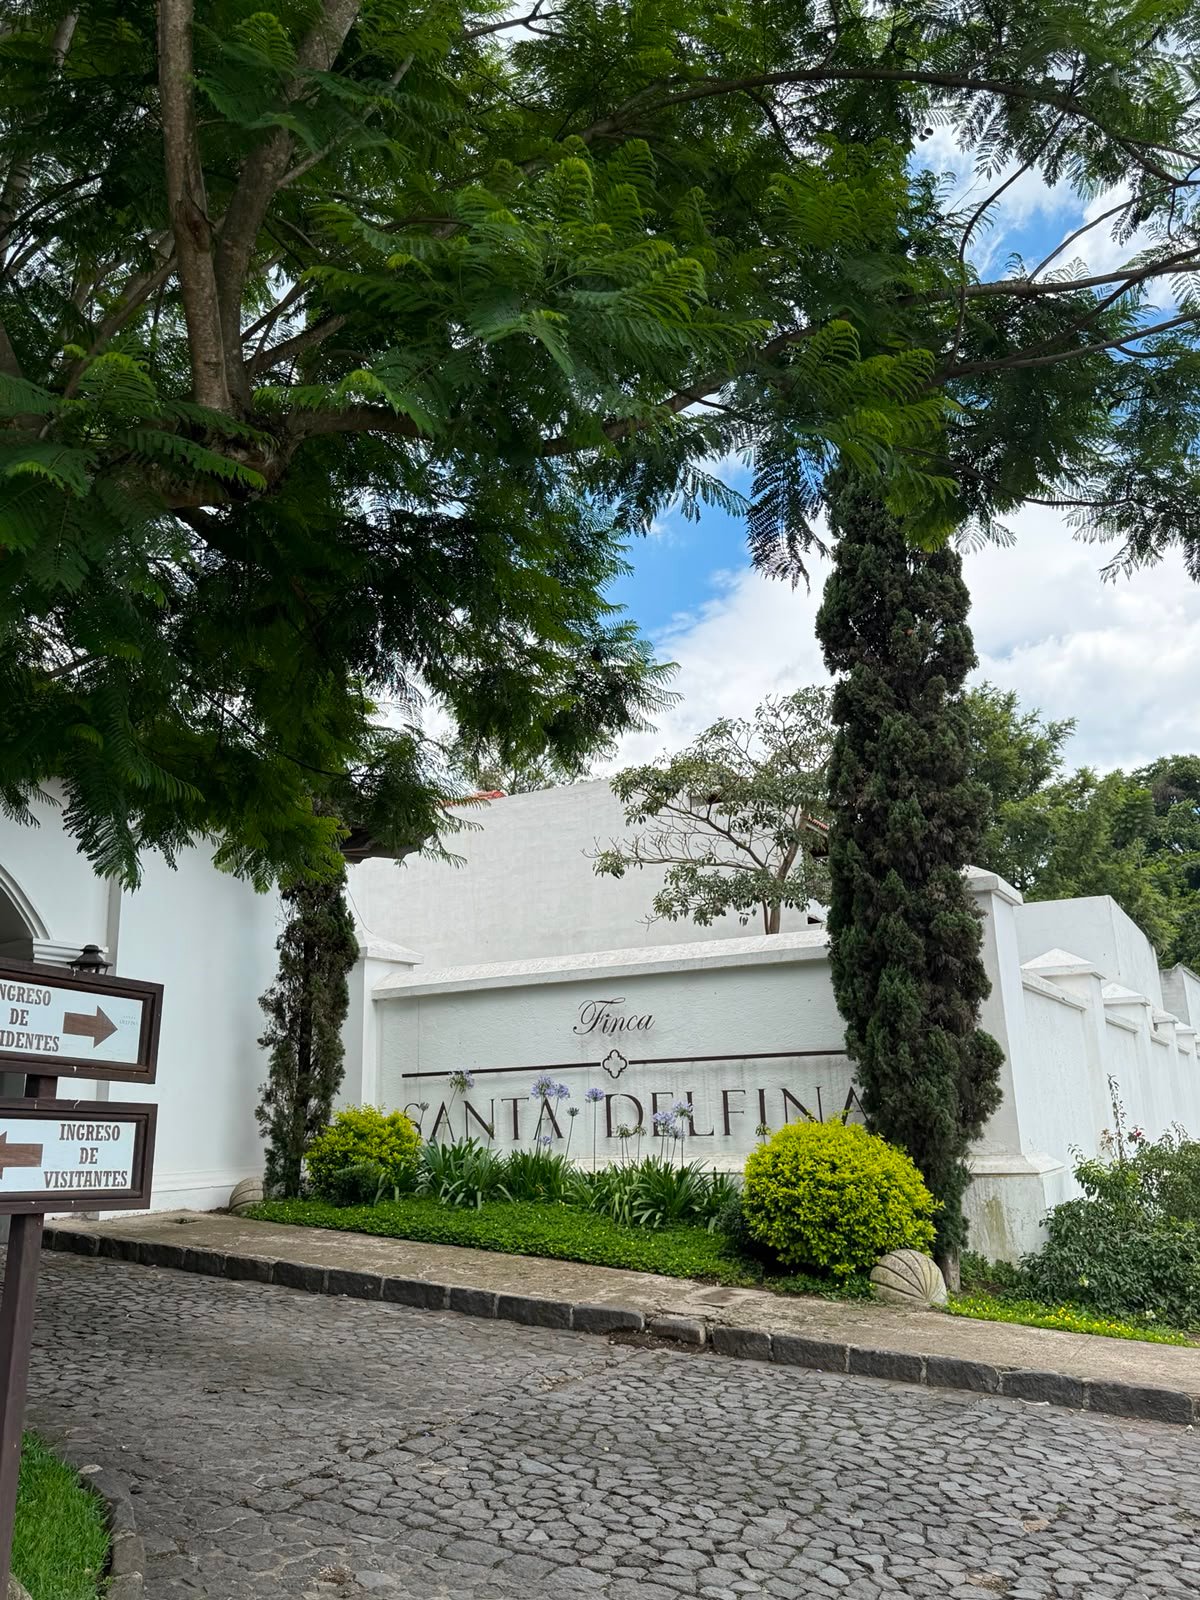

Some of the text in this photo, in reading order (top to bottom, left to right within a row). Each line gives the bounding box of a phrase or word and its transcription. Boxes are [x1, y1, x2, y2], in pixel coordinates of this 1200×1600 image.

[9, 1007, 30, 1027] DE
[572, 997, 656, 1035] Finca
[403, 1086, 869, 1143] SANTA DELFINA
[59, 1123, 121, 1142] INGRESO
[79, 1147, 99, 1165] DE
[43, 1170, 128, 1189] VISITANTES
